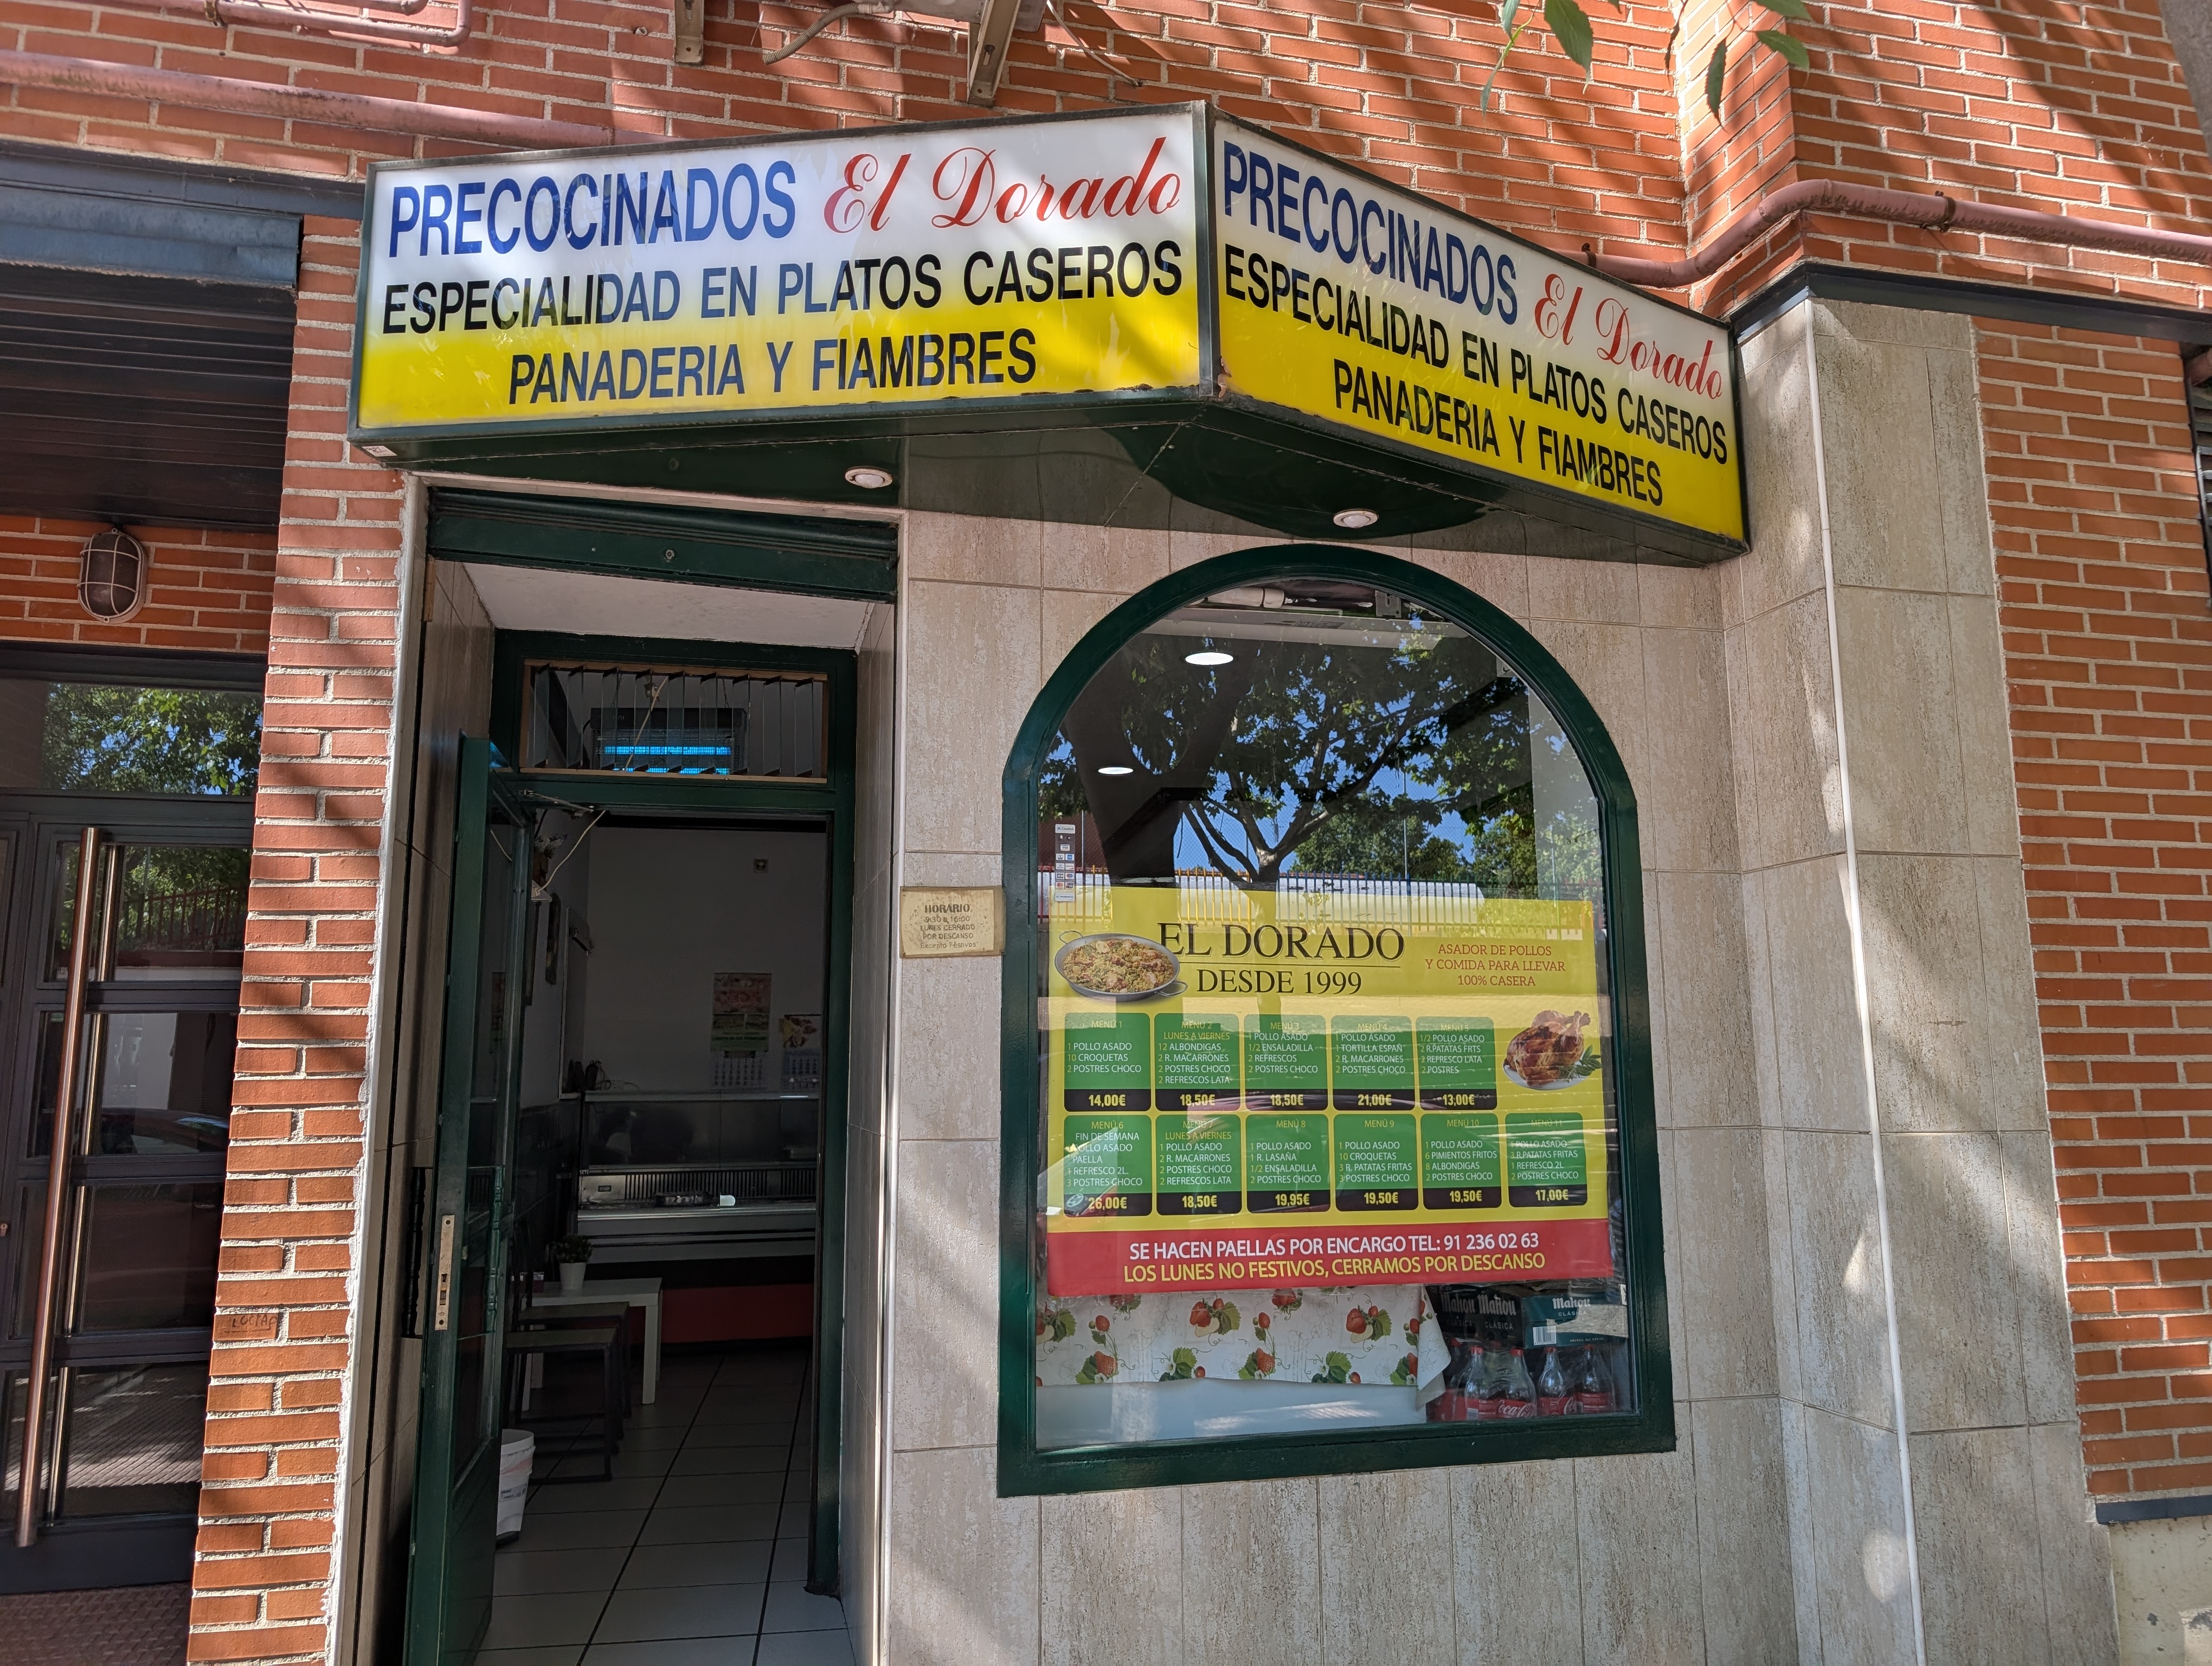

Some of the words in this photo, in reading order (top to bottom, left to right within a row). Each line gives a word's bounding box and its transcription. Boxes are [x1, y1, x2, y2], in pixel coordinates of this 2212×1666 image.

[389, 160, 796, 258] PRECOCINADOS
[824, 153, 911, 234] El
[931, 137, 1180, 228] Dorado
[1223, 141, 1517, 325] PRECOCINADOS
[1534, 274, 1583, 346] El
[1596, 297, 1723, 399] Dorado
[382, 270, 680, 334] ESPECIALIDAD
[701, 265, 757, 319] EN
[778, 254, 942, 314] PLATOS
[964, 240, 1182, 306] CASEROS
[1225, 245, 1449, 368] ESPECIALIDAD
[1462, 330, 1499, 388] EN
[1512, 348, 1606, 424] PLATOS
[1617, 388, 1727, 465] CASEROS
[509, 344, 745, 405] PANADERIA
[767, 341, 794, 393] Y
[812, 328, 1036, 391] FIAMBRES
[1333, 358, 1500, 457] PANADERIA
[1508, 415, 1525, 464] Y
[1538, 427, 1663, 507] FIAMBRES
[924, 904, 970, 913] HORARIO
[920, 941, 947, 950] Excepto
[1158, 922, 1212, 957] EL
[1223, 924, 1405, 961] DORADO
[1438, 944, 1487, 956] ASADOR
[1491, 945, 1506, 956] DE
[1509, 945, 1552, 956] POLLOS
[1426, 959, 1433, 969] Y
[1436, 959, 1486, 970] COMIDA
[1488, 960, 1520, 971] PARA
[1522, 960, 1565, 971] LLEVAR
[1197, 969, 1294, 993] DESDE
[1305, 971, 1361, 995] 1999
[1458, 975, 1487, 985] 100%
[1490, 976, 1536, 986] CASERA
[1091, 1020, 1116, 1028] MENÚ
[1181, 1020, 1205, 1029] MENÚ
[1270, 1022, 1292, 1030] MENÚ
[1441, 1023, 1463, 1031] MENÚ
[1073, 1042, 1101, 1050] POLLO
[1103, 1042, 1132, 1050] ASADO
[1078, 1054, 1128, 1062] CROQUETAS
[1089, 1094, 1126, 1107] 14,00€
[1180, 1094, 1215, 1106] 18,50€
[1270, 1094, 1303, 1106] 18,50€
[1358, 1094, 1392, 1106] 21,00€
[1443, 1094, 1475, 1106] 13,00€
[1091, 1120, 1116, 1129] MENÚ
[1276, 1119, 1299, 1128] MENÚ
[1365, 1119, 1387, 1127] MENÚ
[1447, 1118, 1469, 1127] MENÚ
[1265, 1152, 1297, 1161] LASAÑA
[1350, 1152, 1396, 1161] CROQUETAS
[1275, 1193, 1310, 1206] 19,95€
[1364, 1192, 1399, 1204] 19,50€
[1450, 1190, 1482, 1202] 19,50€
[1535, 1189, 1569, 1201] 17,00€
[1088, 1196, 1127, 1210] 26,00€
[1182, 1195, 1217, 1208] 18,50€
[1129, 1242, 1150, 1260] SE
[1154, 1240, 1212, 1259] HACEN
[1217, 1239, 1285, 1257] PAELLAS
[1290, 1237, 1323, 1255] POR
[1327, 1235, 1406, 1255] ENCARGO
[1409, 1234, 1441, 1252] TEL:
[1444, 1234, 1461, 1251] 91
[1466, 1233, 1495, 1250] 236
[1498, 1233, 1518, 1249] 02
[1521, 1232, 1539, 1248] 63
[1124, 1264, 1156, 1283] LOS
[1161, 1263, 1214, 1281] LUNES
[1219, 1261, 1245, 1279] NO
[1249, 1259, 1328, 1279] FESTIVOS,
[1332, 1256, 1420, 1276] CERRAMOS
[1424, 1254, 1458, 1272] POR
[1461, 1252, 1545, 1272] DESCANSO
[1441, 1293, 1475, 1313] Mahou
[1477, 1294, 1516, 1316] Mahou
[1553, 1297, 1591, 1309] Mahou
[1484, 1321, 1513, 1330] CLÁSICA
